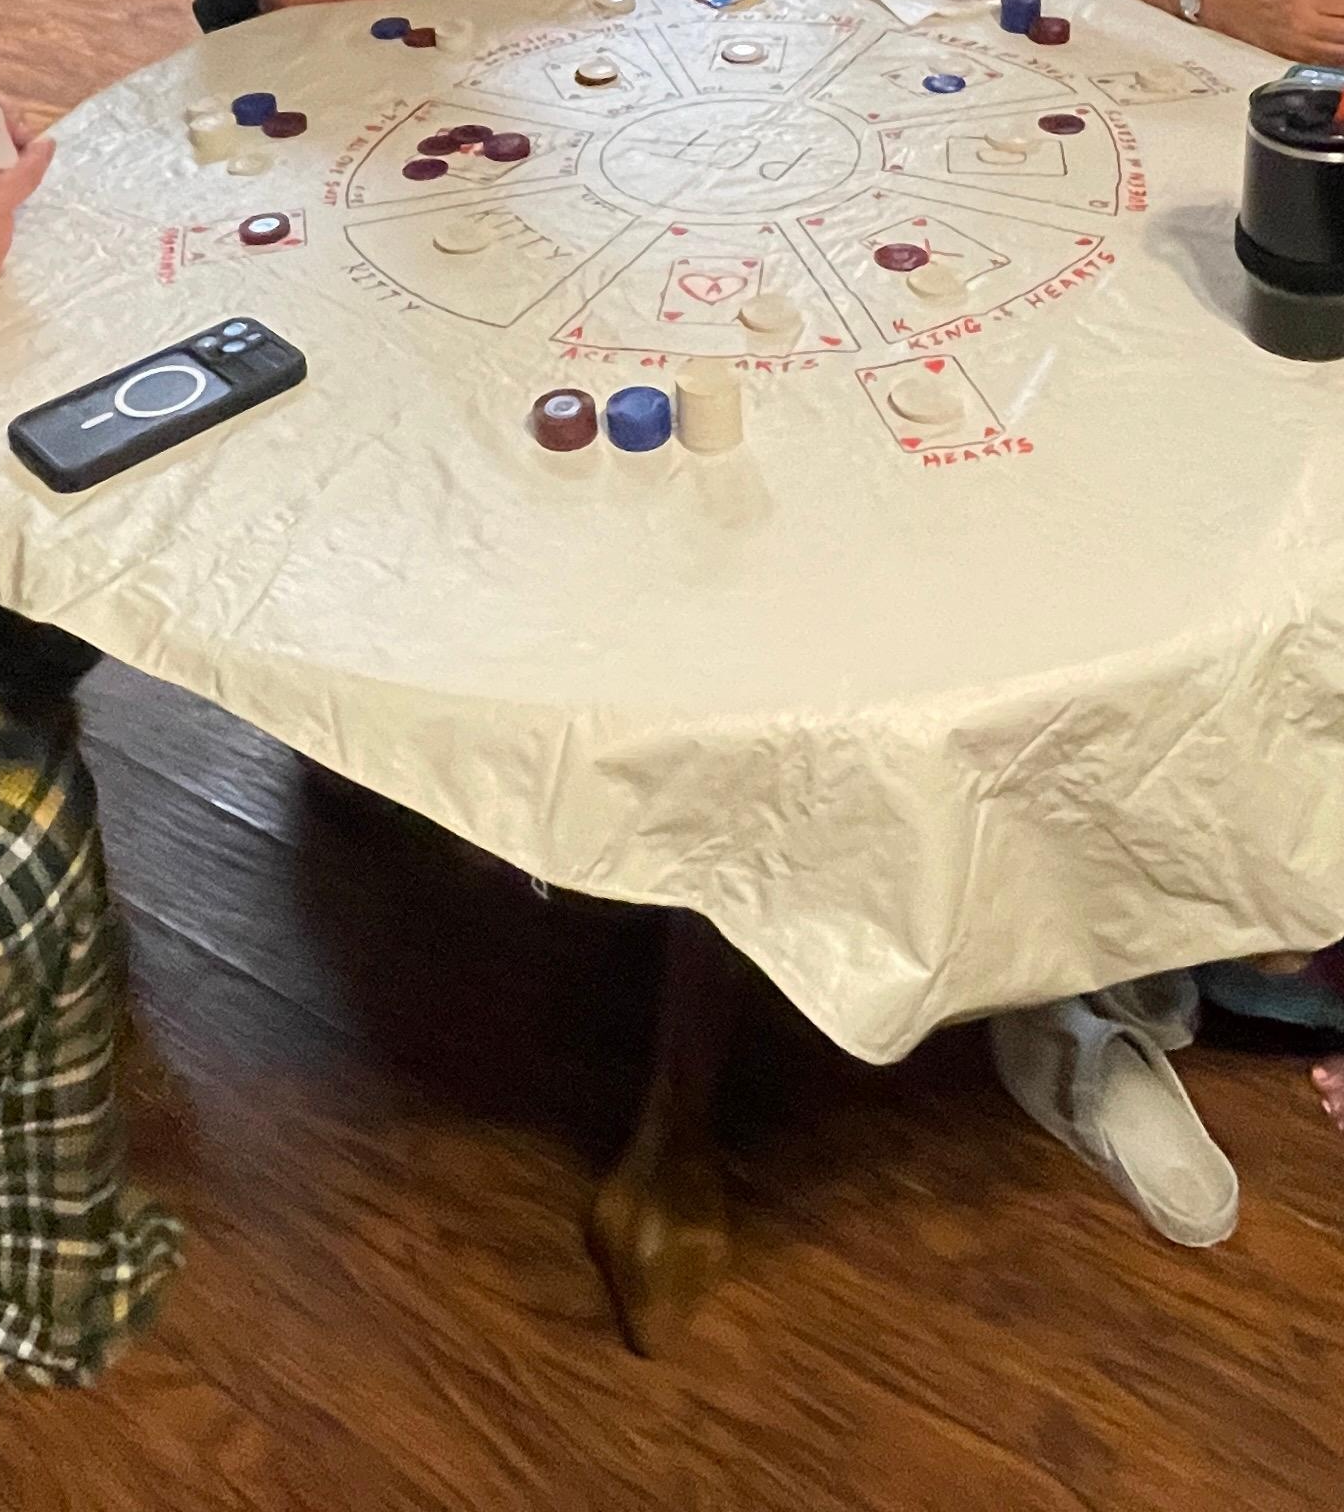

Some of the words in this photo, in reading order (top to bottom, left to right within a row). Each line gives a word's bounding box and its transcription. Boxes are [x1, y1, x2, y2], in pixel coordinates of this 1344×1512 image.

[340, 261, 421, 313] KITTY
[908, 318, 982, 351] KING
[1025, 251, 1116, 308] HEARTS
[566, 326, 583, 340] A
[892, 318, 913, 334] K
[560, 347, 616, 363] ACE
[923, 437, 1034, 467] HEARTS
